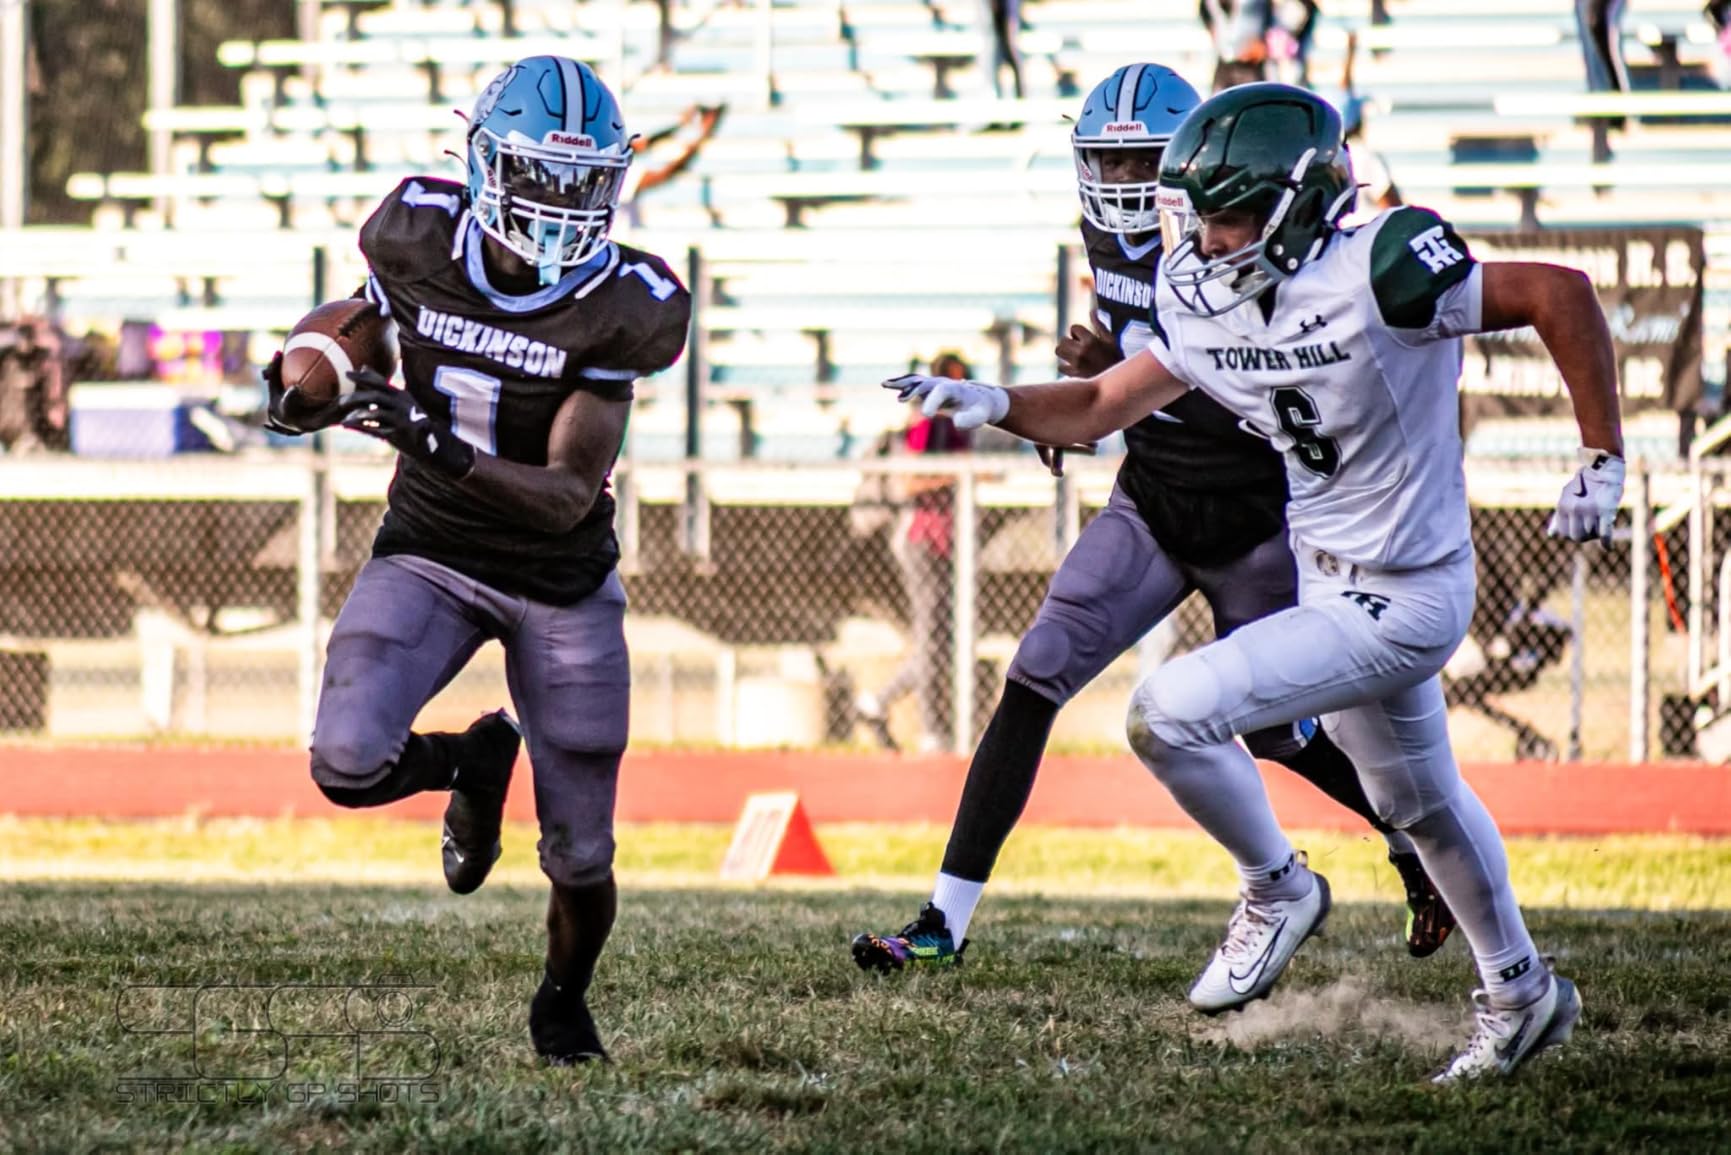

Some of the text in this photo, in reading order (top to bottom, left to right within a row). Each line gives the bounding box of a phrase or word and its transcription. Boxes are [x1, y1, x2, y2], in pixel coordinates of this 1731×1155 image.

[551, 133, 592, 147] Riddell
[1106, 123, 1142, 132] Riddell
[619, 262, 678, 301] 1
[1096, 267, 1155, 310] DICKINSO
[417, 308, 567, 378] DICKINSON
[1205, 341, 1351, 371] TOWER HILL
[433, 365, 502, 457] 1
[1269, 386, 1343, 480] 6
